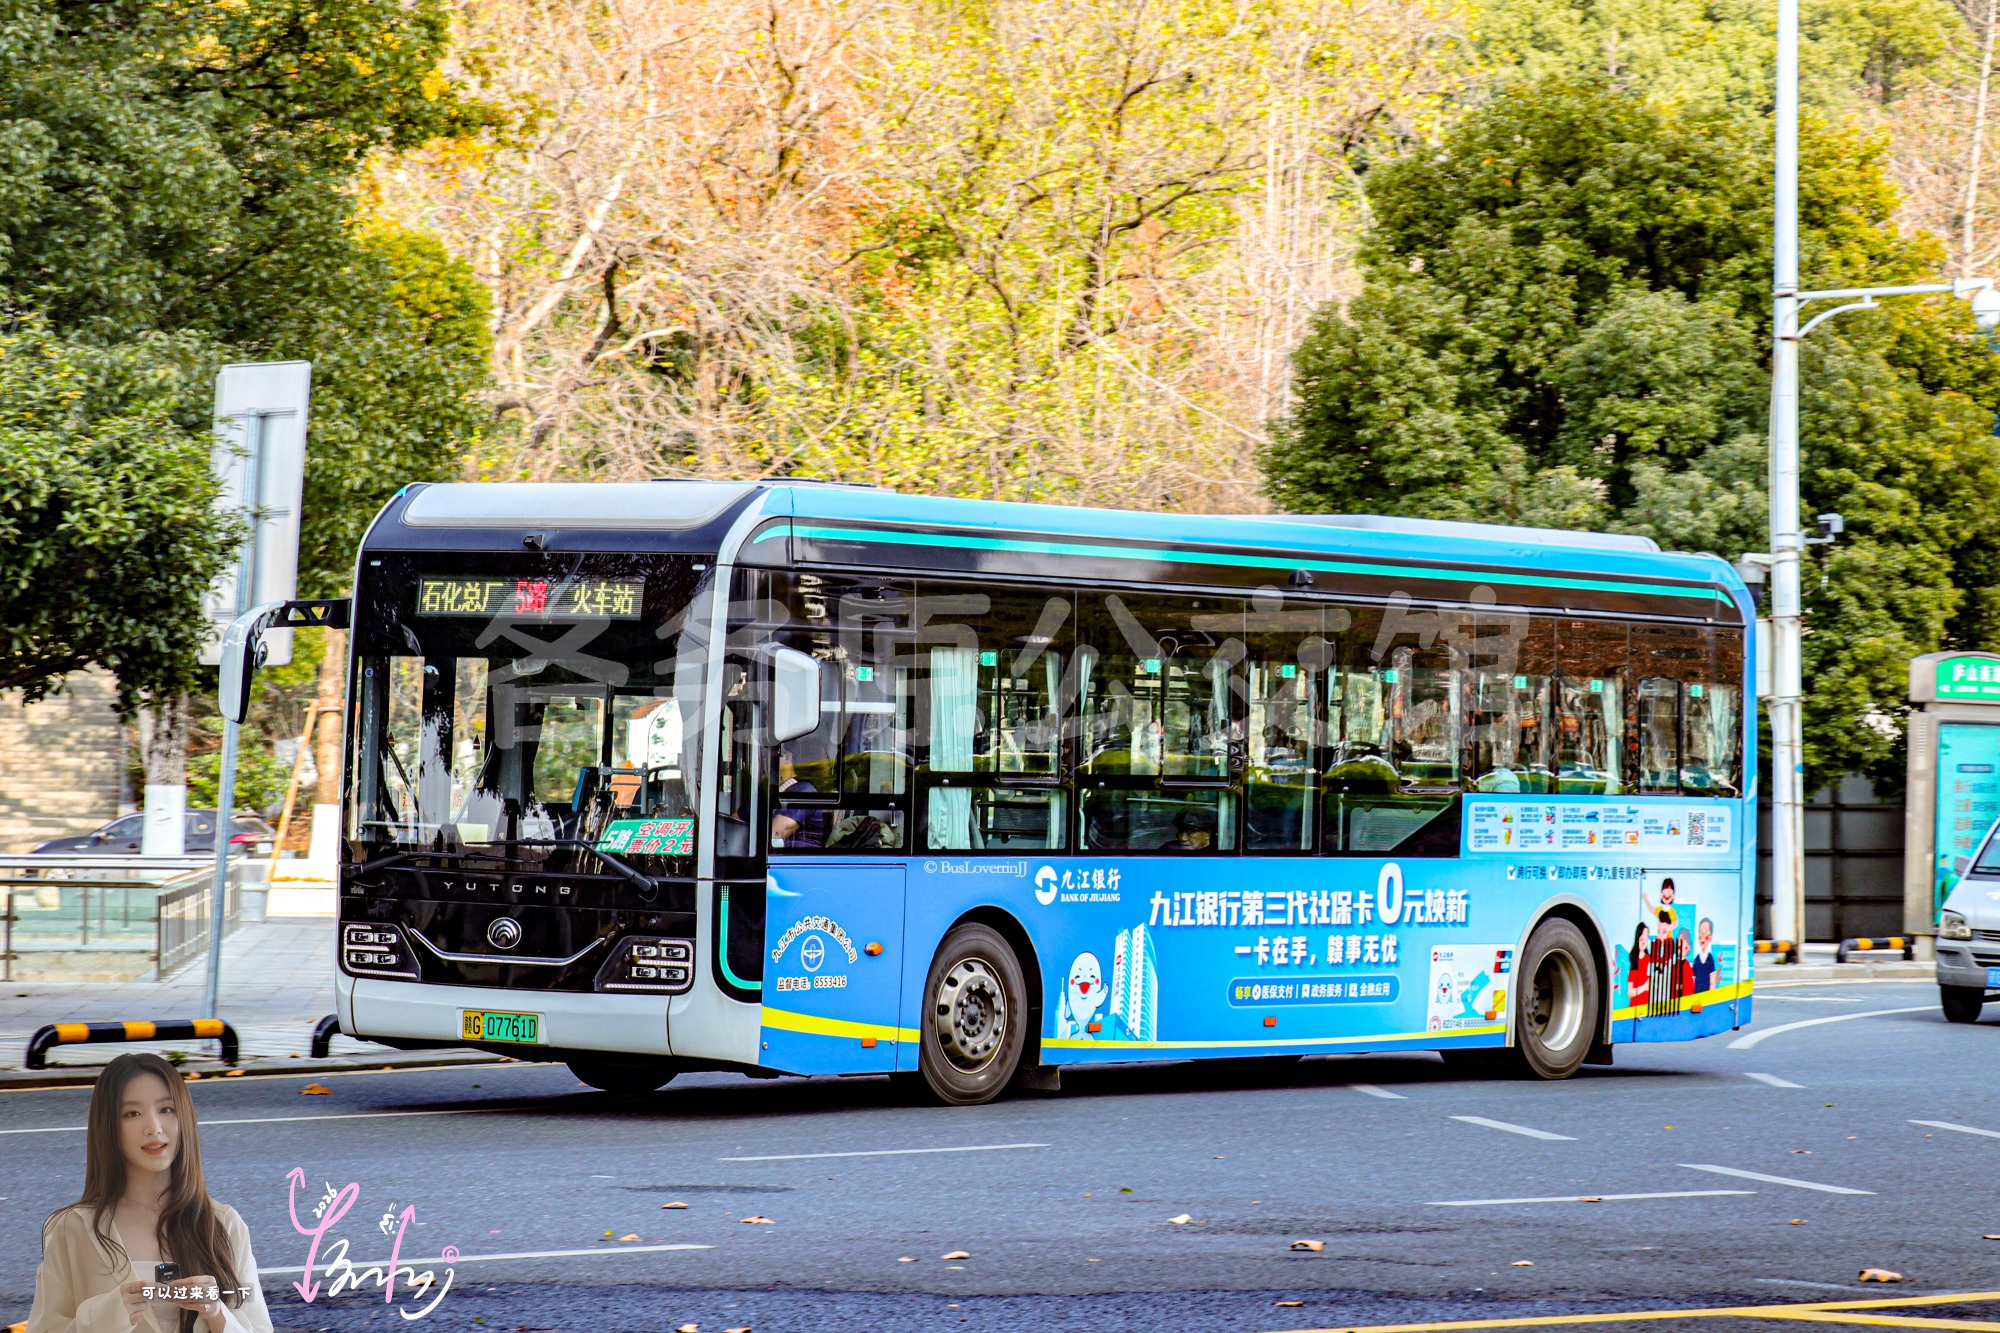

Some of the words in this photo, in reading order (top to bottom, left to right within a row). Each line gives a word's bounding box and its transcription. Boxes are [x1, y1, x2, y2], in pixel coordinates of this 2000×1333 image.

[422, 581, 503, 612] 石化总厂
[515, 580, 548, 614] 5路
[570, 582, 635, 615] 火车站
[602, 829, 633, 850] 5路
[443, 881, 571, 895] YUTONG
[1060, 868, 1121, 891] 九江银行
[1060, 893, 1079, 902] BANK
[1080, 893, 1088, 902] OF
[1089, 893, 1121, 903] JIUJIANG
[772, 915, 858, 963] 九江市公共交通集团公司
[1235, 985, 1252, 1000] 畅享
[1261, 984, 1294, 999] 医保支付
[1310, 983, 1343, 998] 政务服务
[1359, 982, 1391, 997] 金融应用
